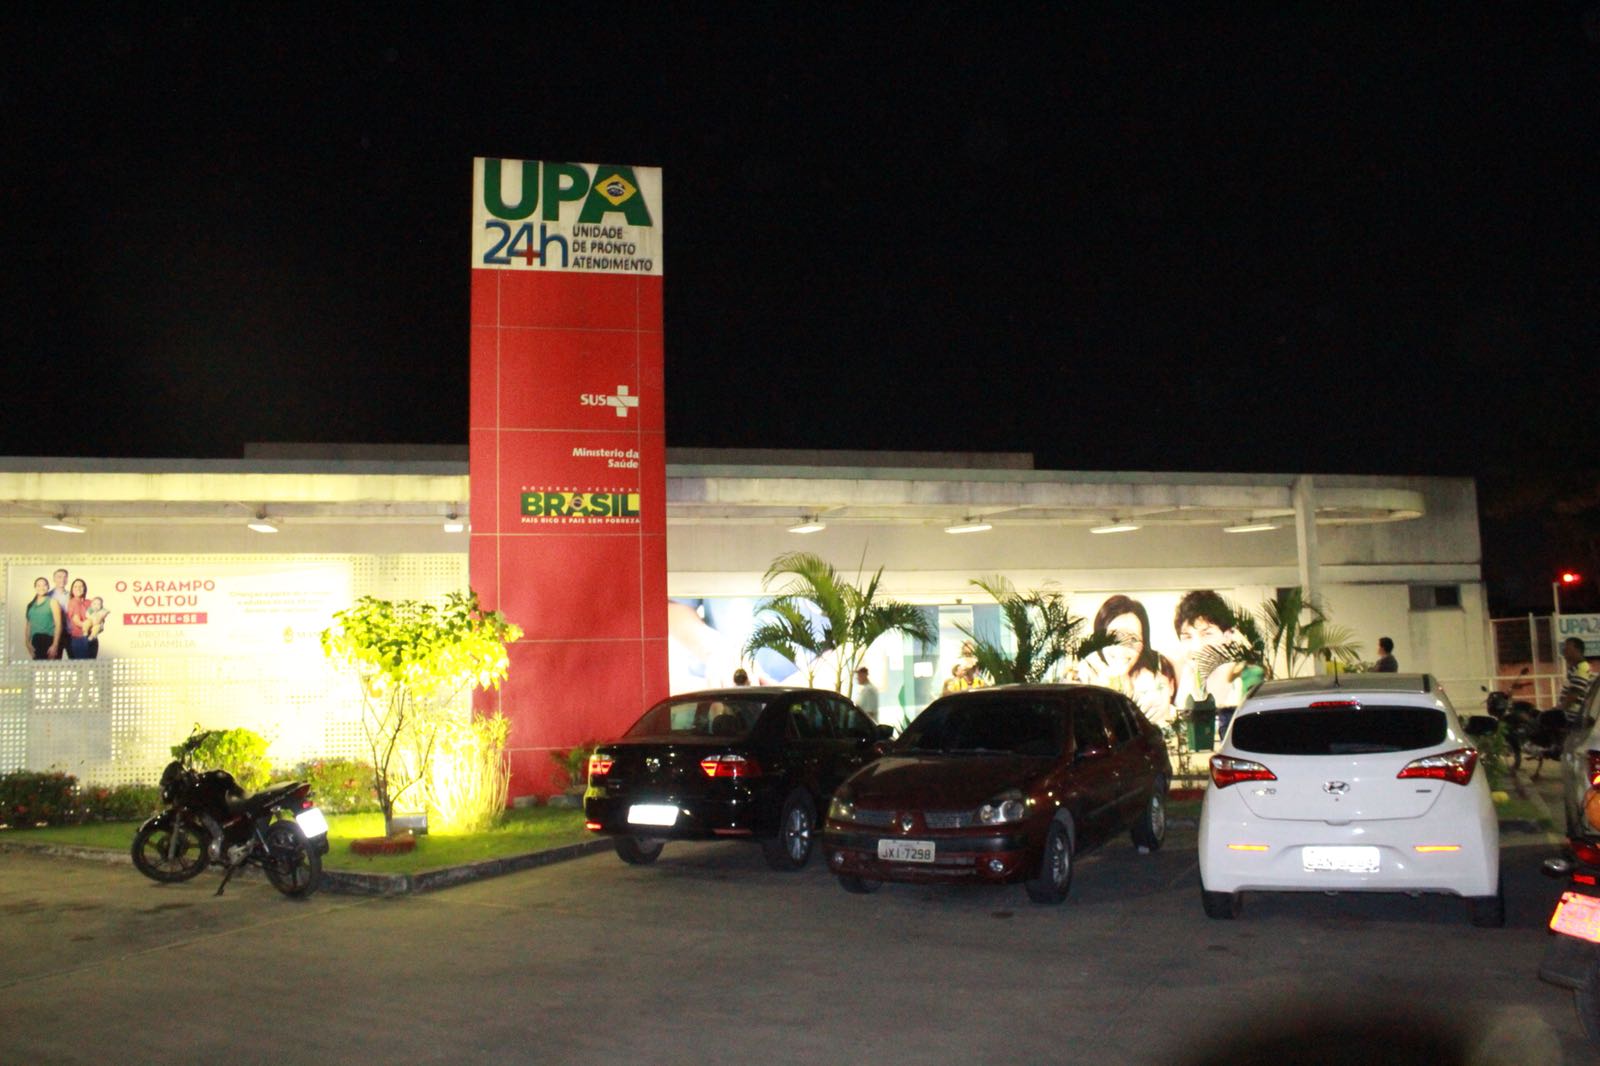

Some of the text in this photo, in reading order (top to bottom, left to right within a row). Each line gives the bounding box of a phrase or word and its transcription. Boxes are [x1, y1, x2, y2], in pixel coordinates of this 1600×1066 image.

[484, 158, 653, 227] UPA
[572, 226, 623, 240] UNIDADE
[483, 220, 568, 268] 24h
[572, 241, 636, 256] DE PRONTO
[572, 257, 653, 271] ATENDIMENTO
[580, 394, 607, 406] SUS
[626, 449, 639, 459] da
[608, 459, 639, 469] Saúde
[521, 492, 640, 516] BRASIL
[115, 580, 215, 592] O SARAMPO
[133, 595, 197, 607] VOLTOU
[130, 614, 197, 624] VACINE-SE
